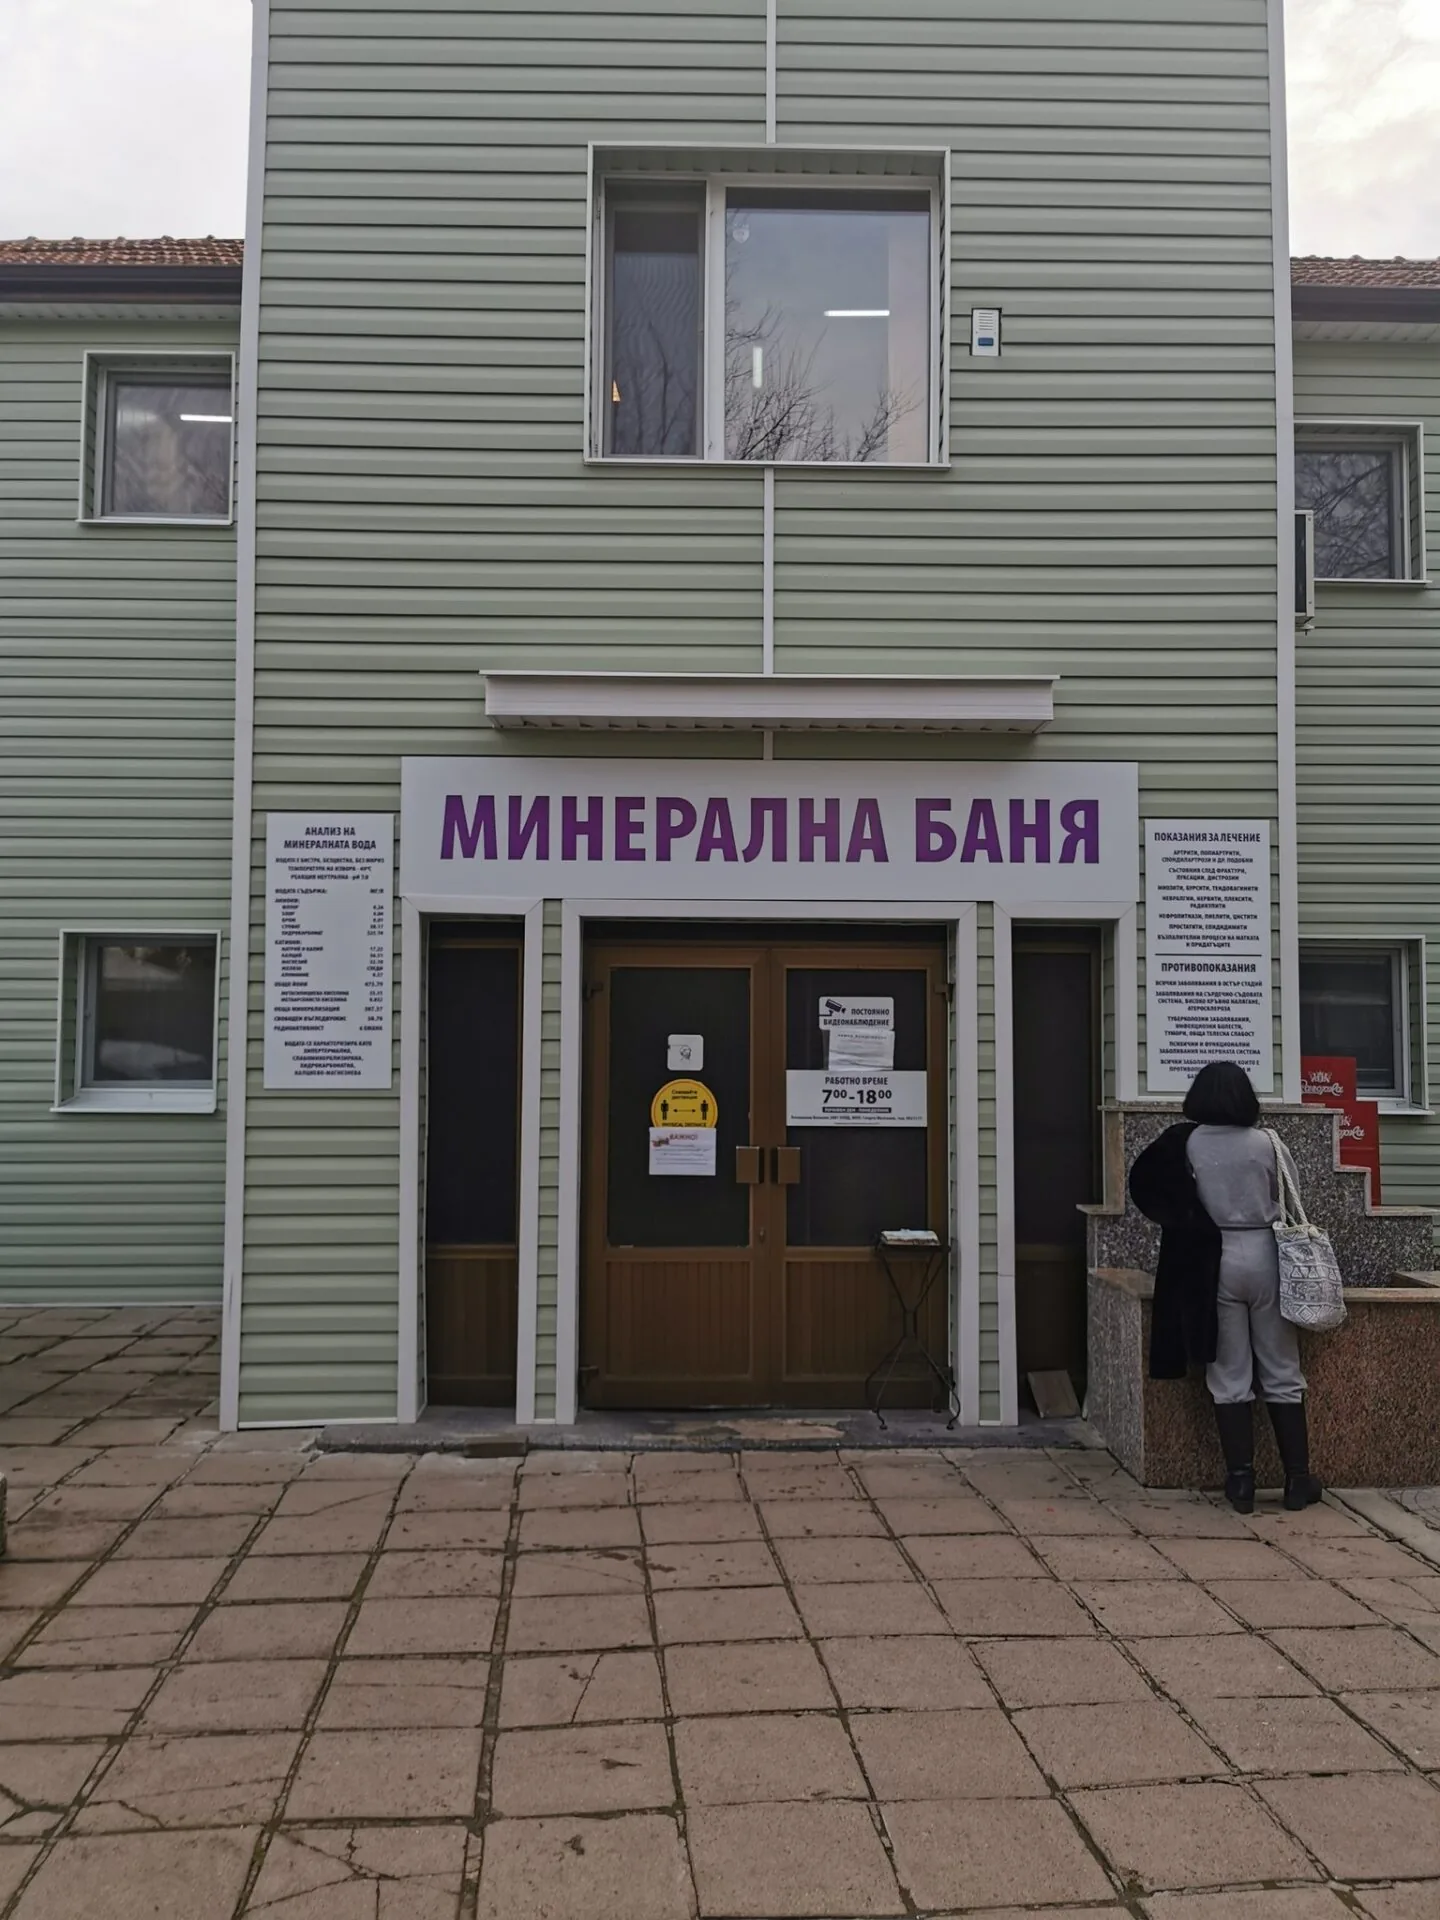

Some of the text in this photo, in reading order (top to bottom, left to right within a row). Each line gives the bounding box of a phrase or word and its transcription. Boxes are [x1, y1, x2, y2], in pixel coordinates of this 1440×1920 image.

[305, 827, 356, 835] АНАЛИЗ НА
[440, 794, 1100, 864] МИНЕРАЛНА БАНЯ
[1154, 832, 1261, 842] ПОКАЗАНИЯ ЗА ЛЕЧЕНИЕ
[284, 840, 376, 849] МИНЕРАЛНАТА ВОДА
[1161, 963, 1256, 972] ПРОТИВОПОКАЗАНИЯ
[823, 1018, 889, 1027] ВИДЕОНАБЛЮДЕНИЕ
[825, 1077, 888, 1085] РАБОТНО ВРЕМЕ
